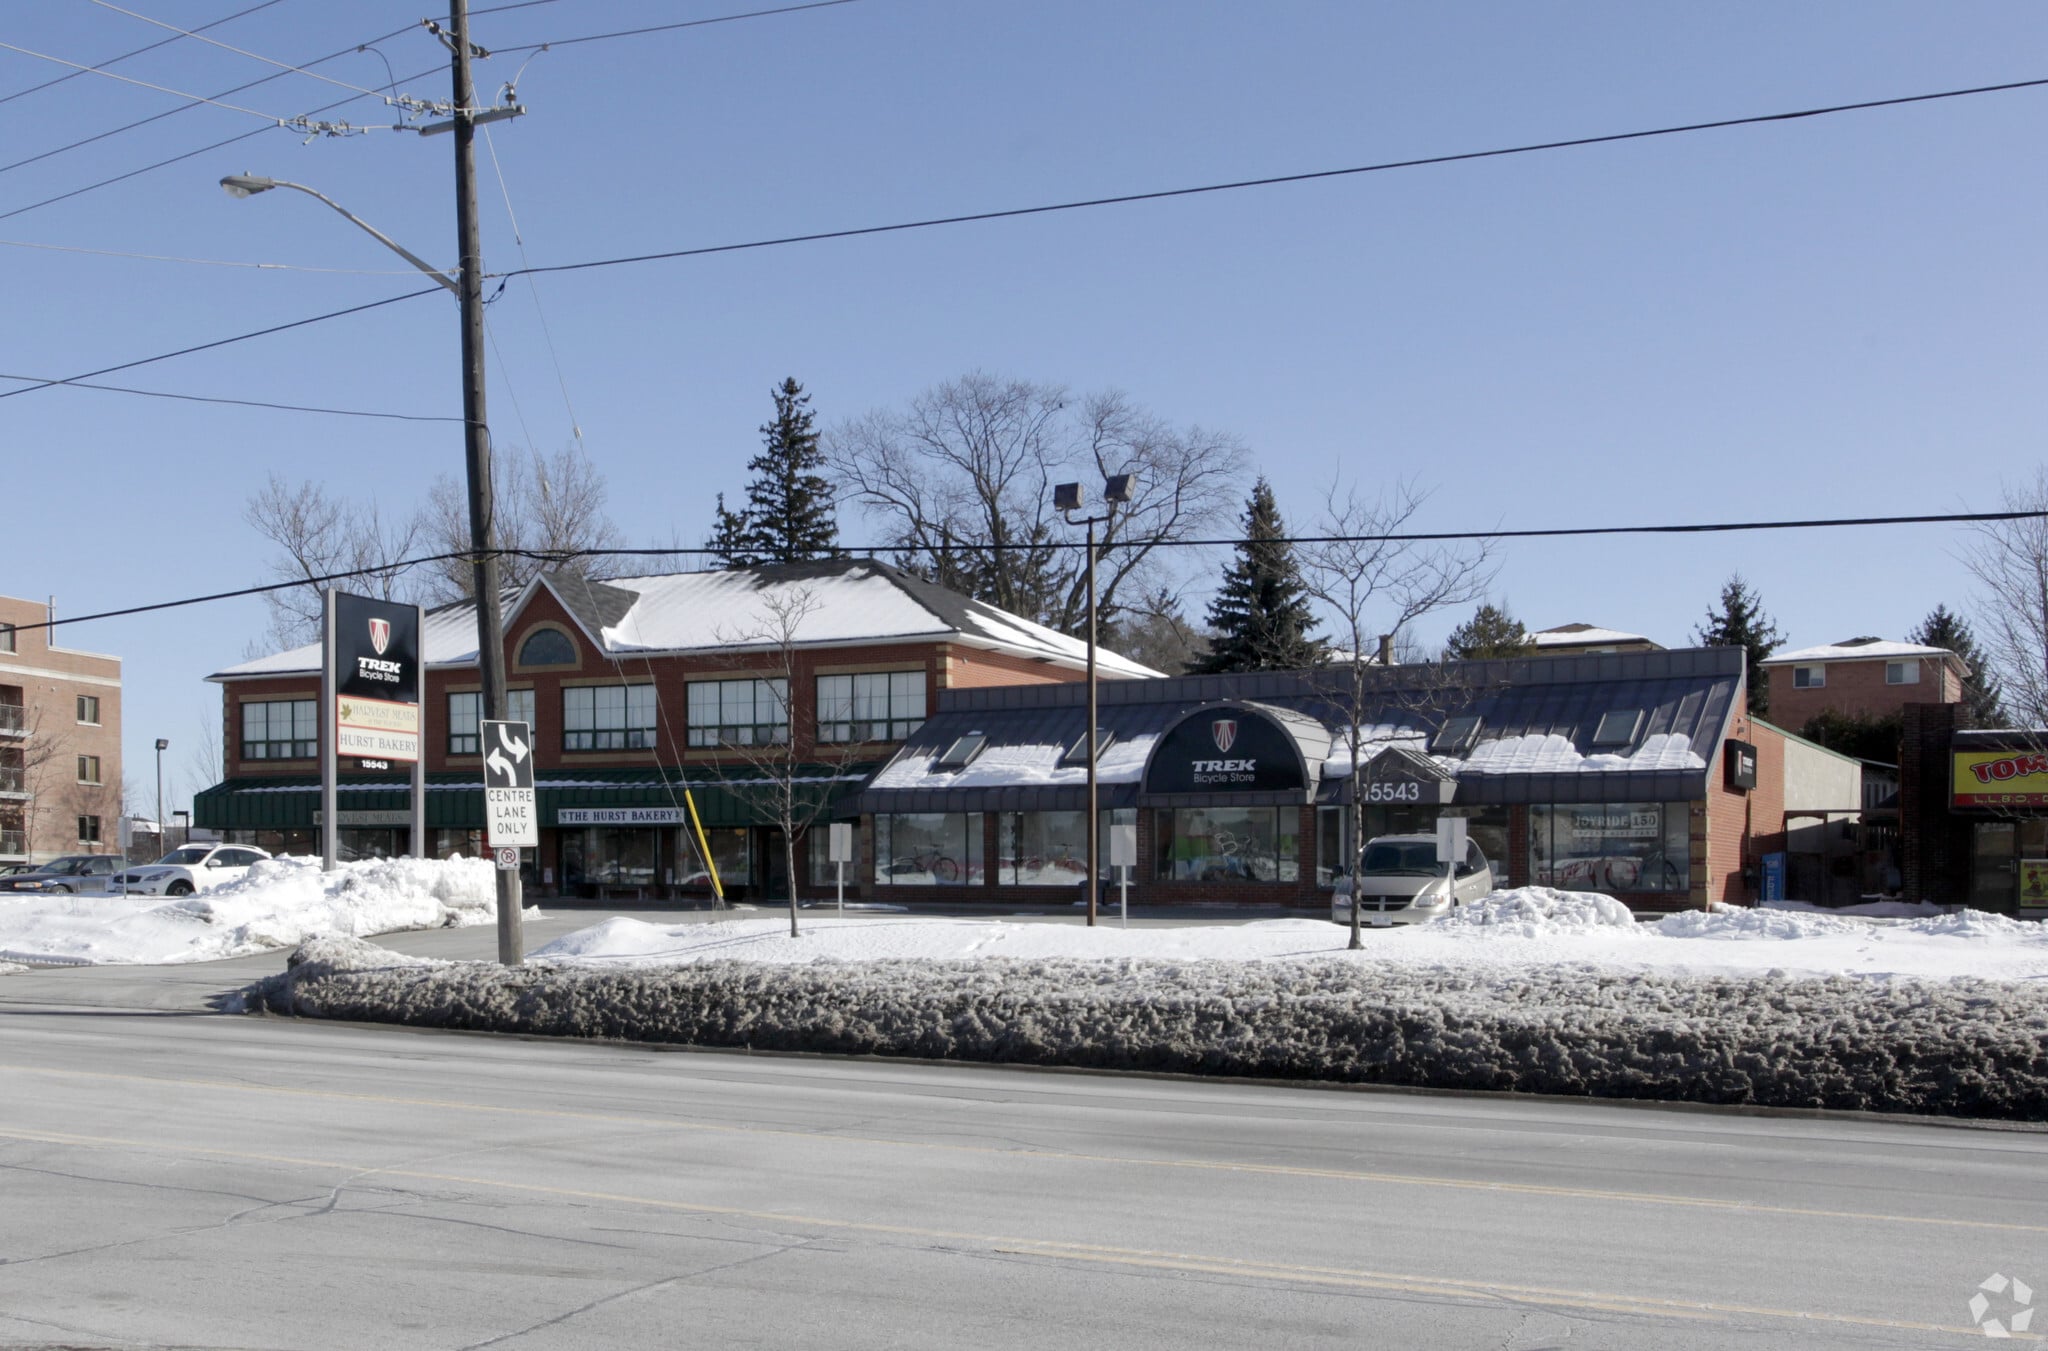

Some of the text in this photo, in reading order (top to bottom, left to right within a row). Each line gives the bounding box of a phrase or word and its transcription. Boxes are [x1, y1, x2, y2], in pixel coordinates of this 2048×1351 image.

[358, 656, 401, 674] TREK
[360, 669, 400, 683] Bicycle Store
[352, 704, 416, 721] HARVEST MEATS
[340, 733, 417, 752] HURST BAKERY
[361, 760, 388, 770] 15543
[1192, 759, 1256, 773] TREK
[1194, 772, 1255, 784] Bicycle Store
[488, 790, 532, 802] CENTRE
[496, 806, 527, 818] LANE
[568, 810, 673, 821] THE HURST BAKERY
[1575, 814, 1657, 827] JOYRIDE 150
[497, 822, 527, 834] ONLY
